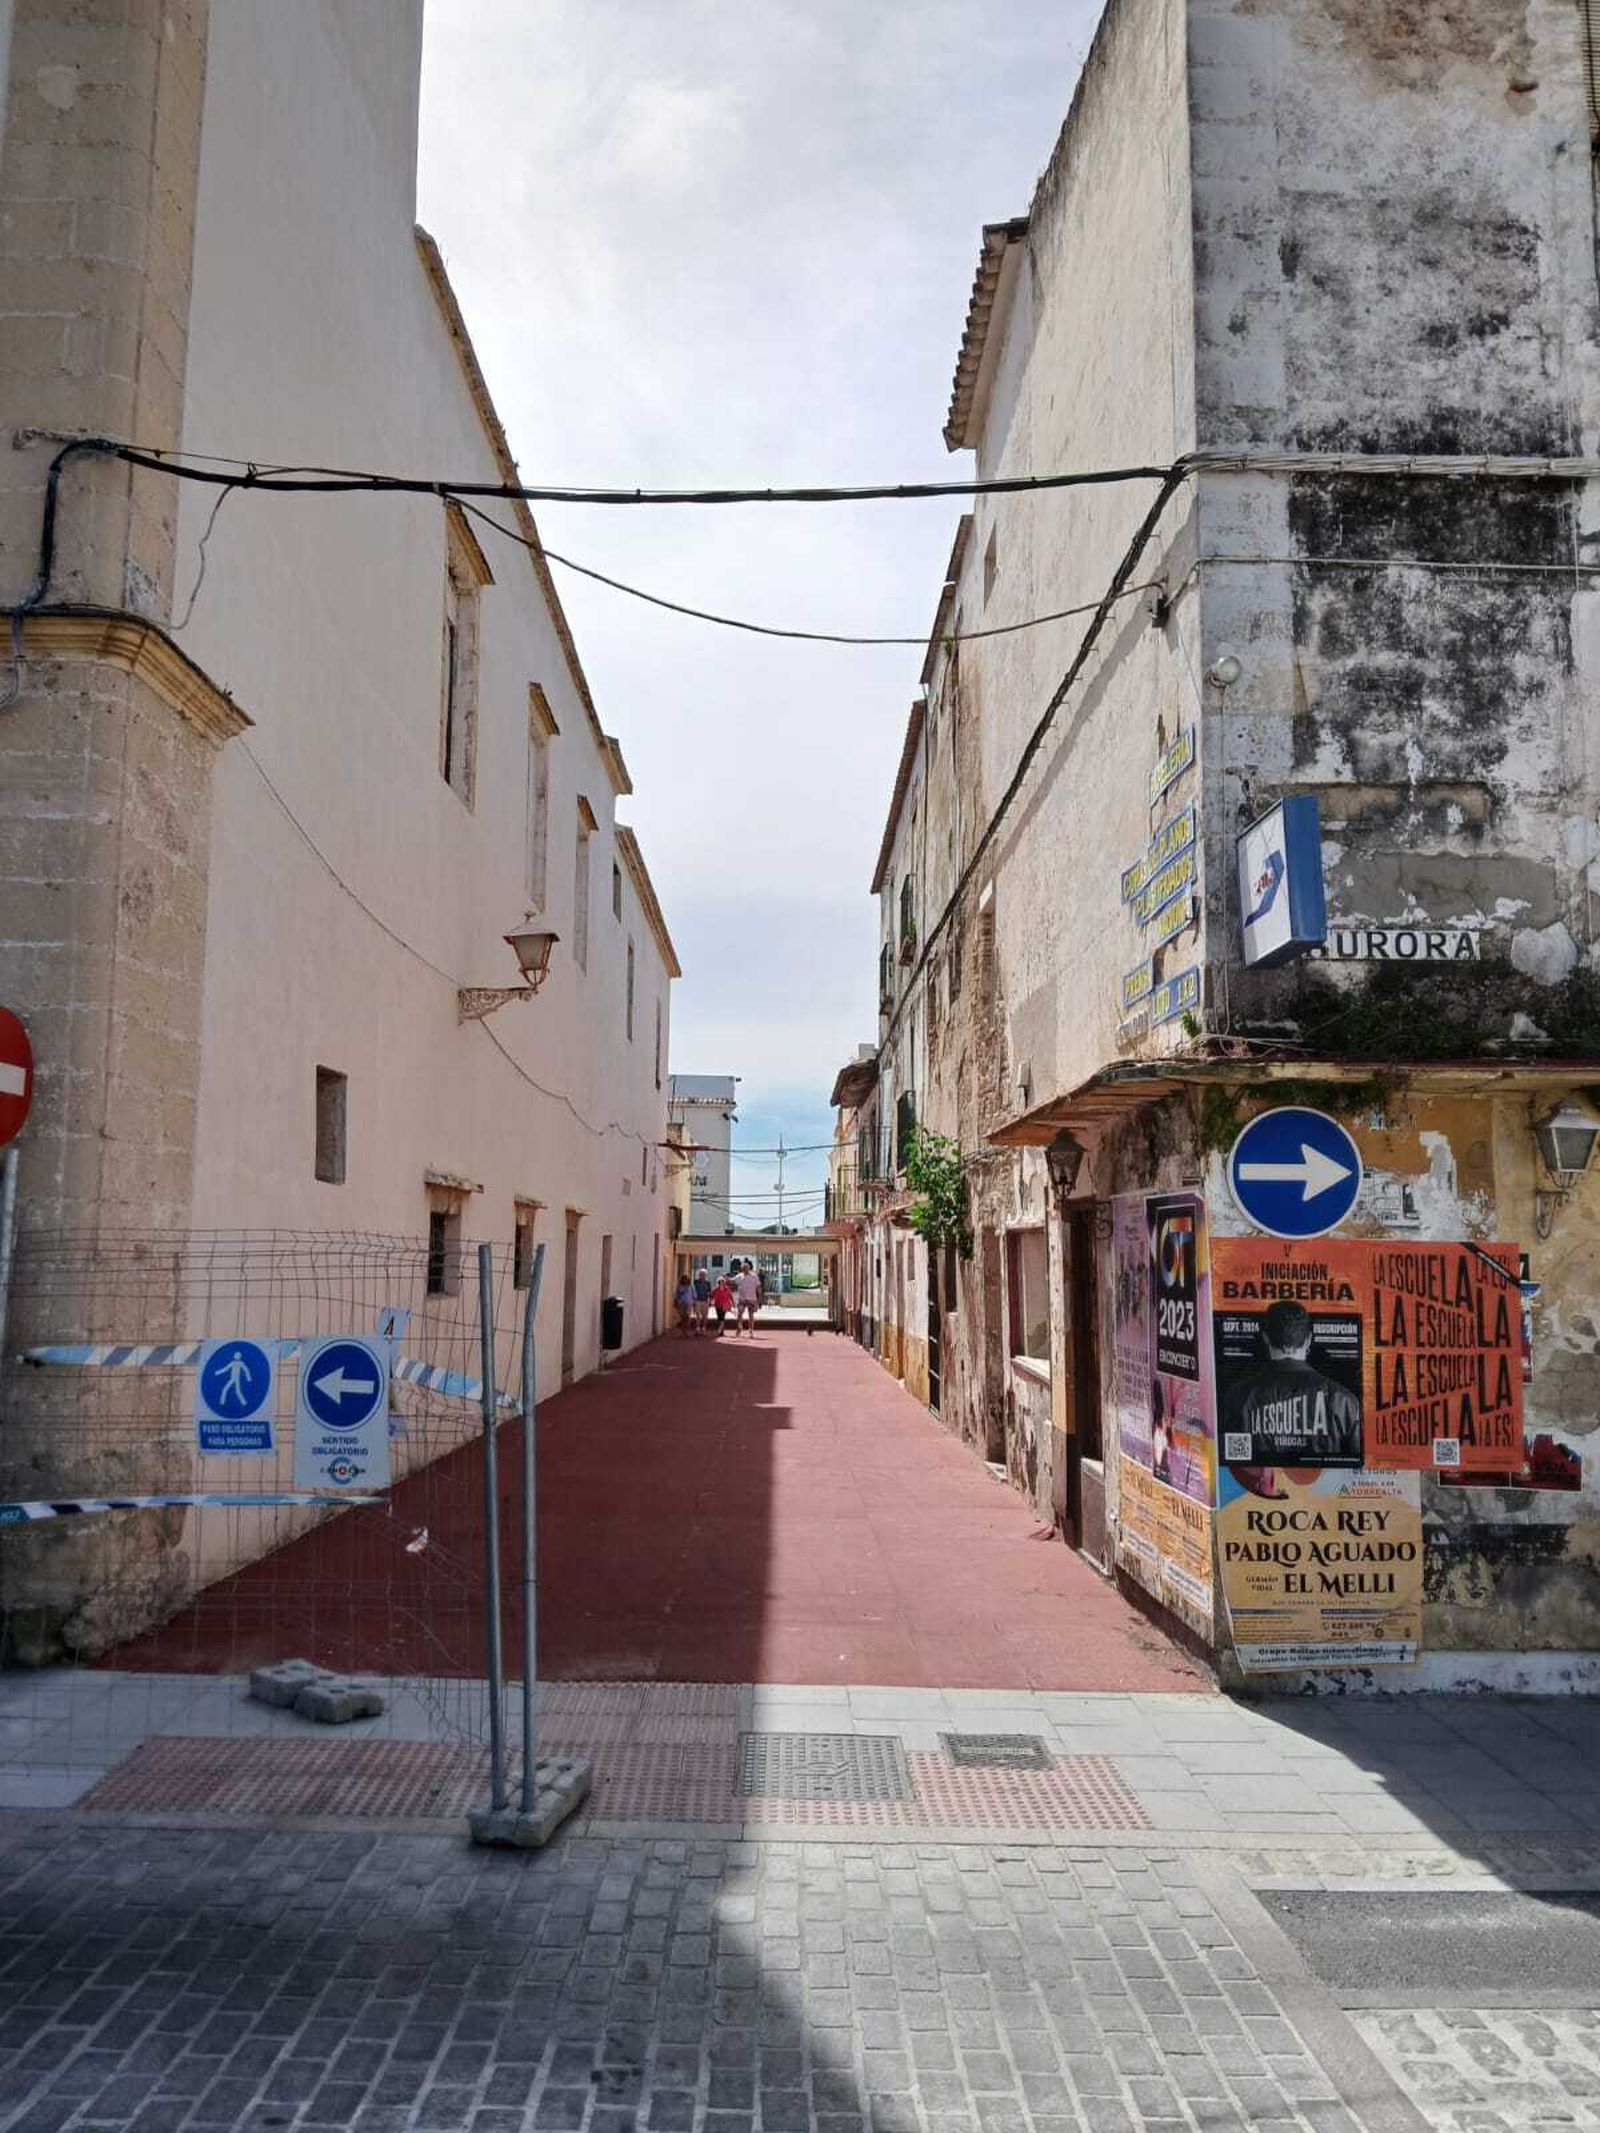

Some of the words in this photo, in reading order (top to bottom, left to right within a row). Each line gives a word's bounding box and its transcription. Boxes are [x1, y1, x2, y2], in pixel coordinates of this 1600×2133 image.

[1260, 1259, 1329, 1281] INICIACIÓN
[1222, 1279, 1355, 1302] BARBERÍA
[1388, 1253, 1473, 1315] ESCUELA
[1159, 1299, 1195, 1342] 2023
[1373, 1287, 1408, 1348] LA
[1414, 1301, 1476, 1350] ESCUELA
[1476, 1287, 1512, 1349] LA
[1375, 1353, 1409, 1411] LA
[1415, 1354, 1476, 1400] ESCUELA
[1477, 1353, 1513, 1416] LA
[1251, 1408, 1262, 1435] LA
[1263, 1389, 1328, 1436] ESCUELA
[311, 1447, 369, 1457] OBLIGATORIO
[321, 1436, 359, 1445] SENTIDO
[1246, 1510, 1329, 1537] ROCA
[1337, 1509, 1391, 1537] REY
[1225, 1541, 1302, 1568] PABLO
[1307, 1541, 1417, 1566] AGUADO
[1284, 1573, 1313, 1594] EL
[1318, 1572, 1395, 1597] MELLI
